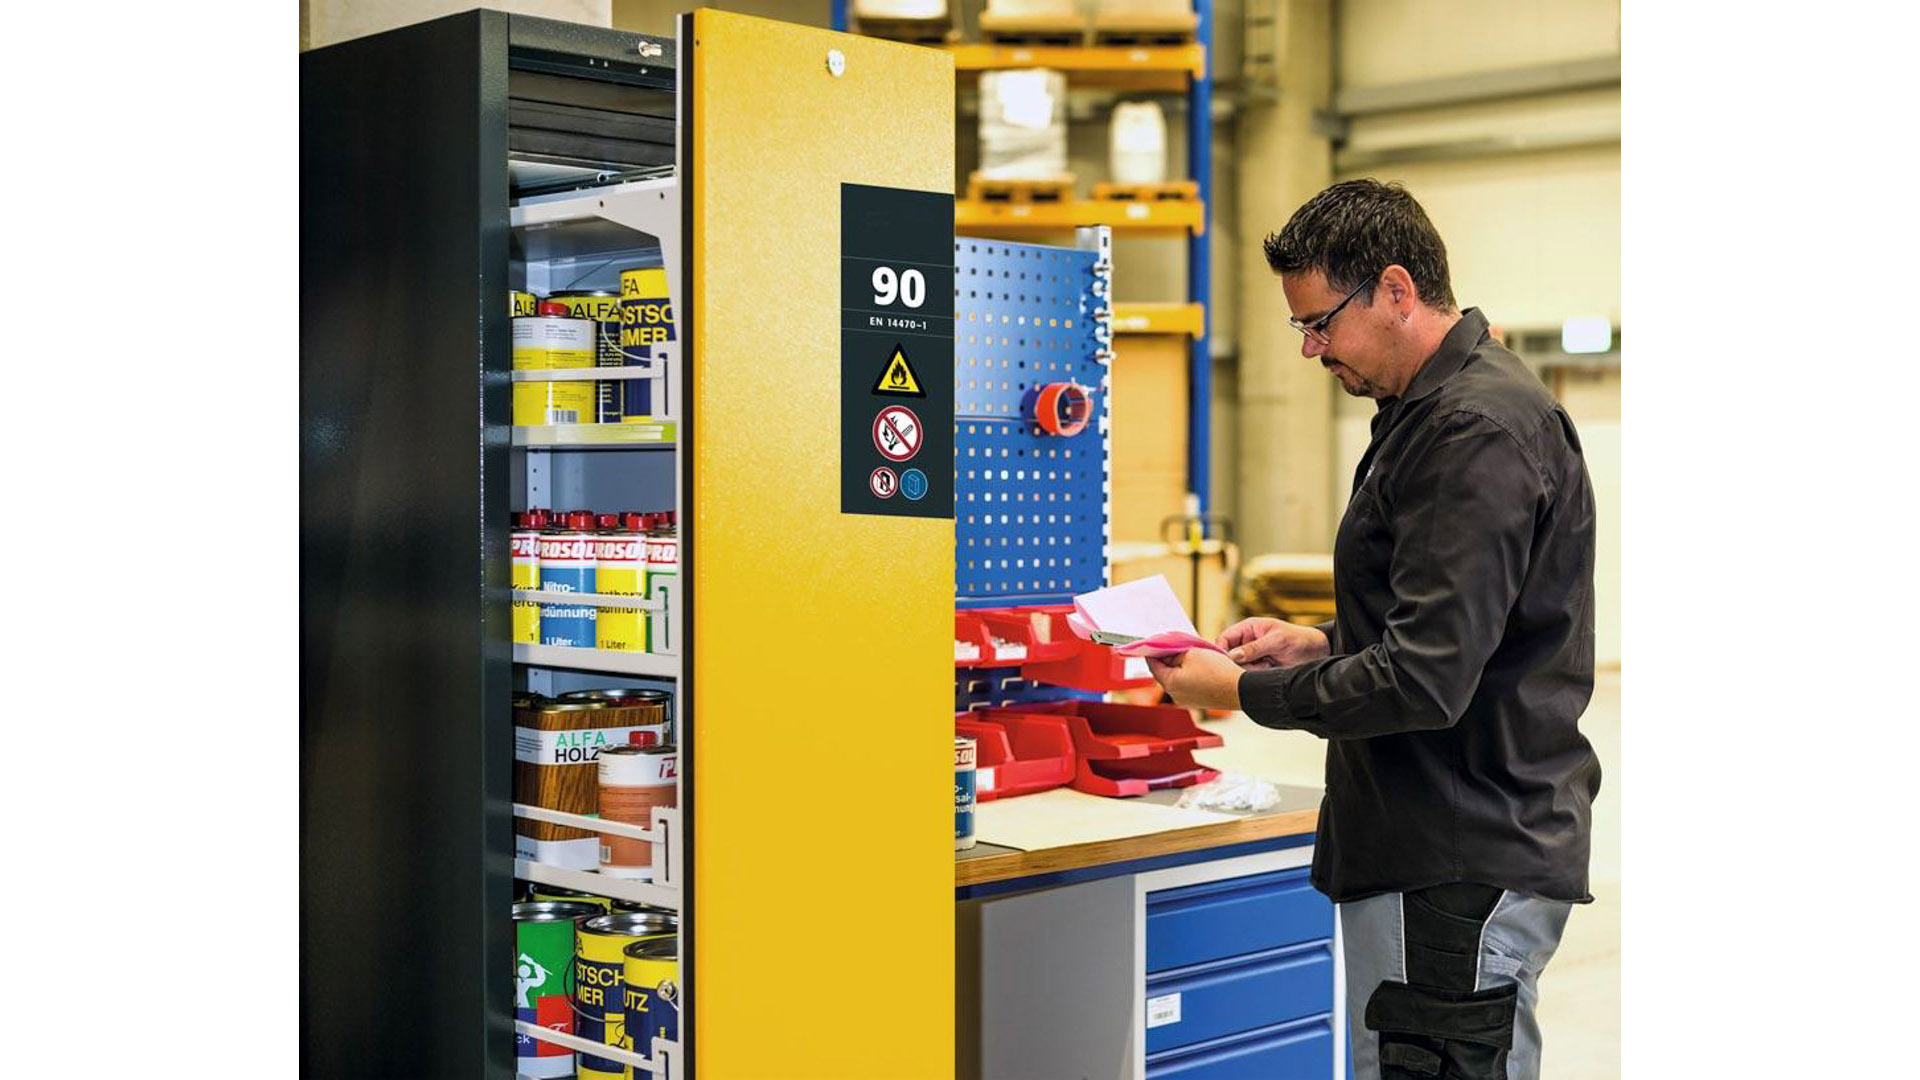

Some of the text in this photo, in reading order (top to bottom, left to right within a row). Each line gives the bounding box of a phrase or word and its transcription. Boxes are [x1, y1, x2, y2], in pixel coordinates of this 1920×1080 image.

[872, 267, 926, 308] 90
[572, 303, 621, 319] ALFA
[869, 316, 927, 330] EN 14470-1
[606, 640, 626, 649] Liter
[556, 731, 606, 747] ALFA
[555, 747, 600, 763] HOLZ
